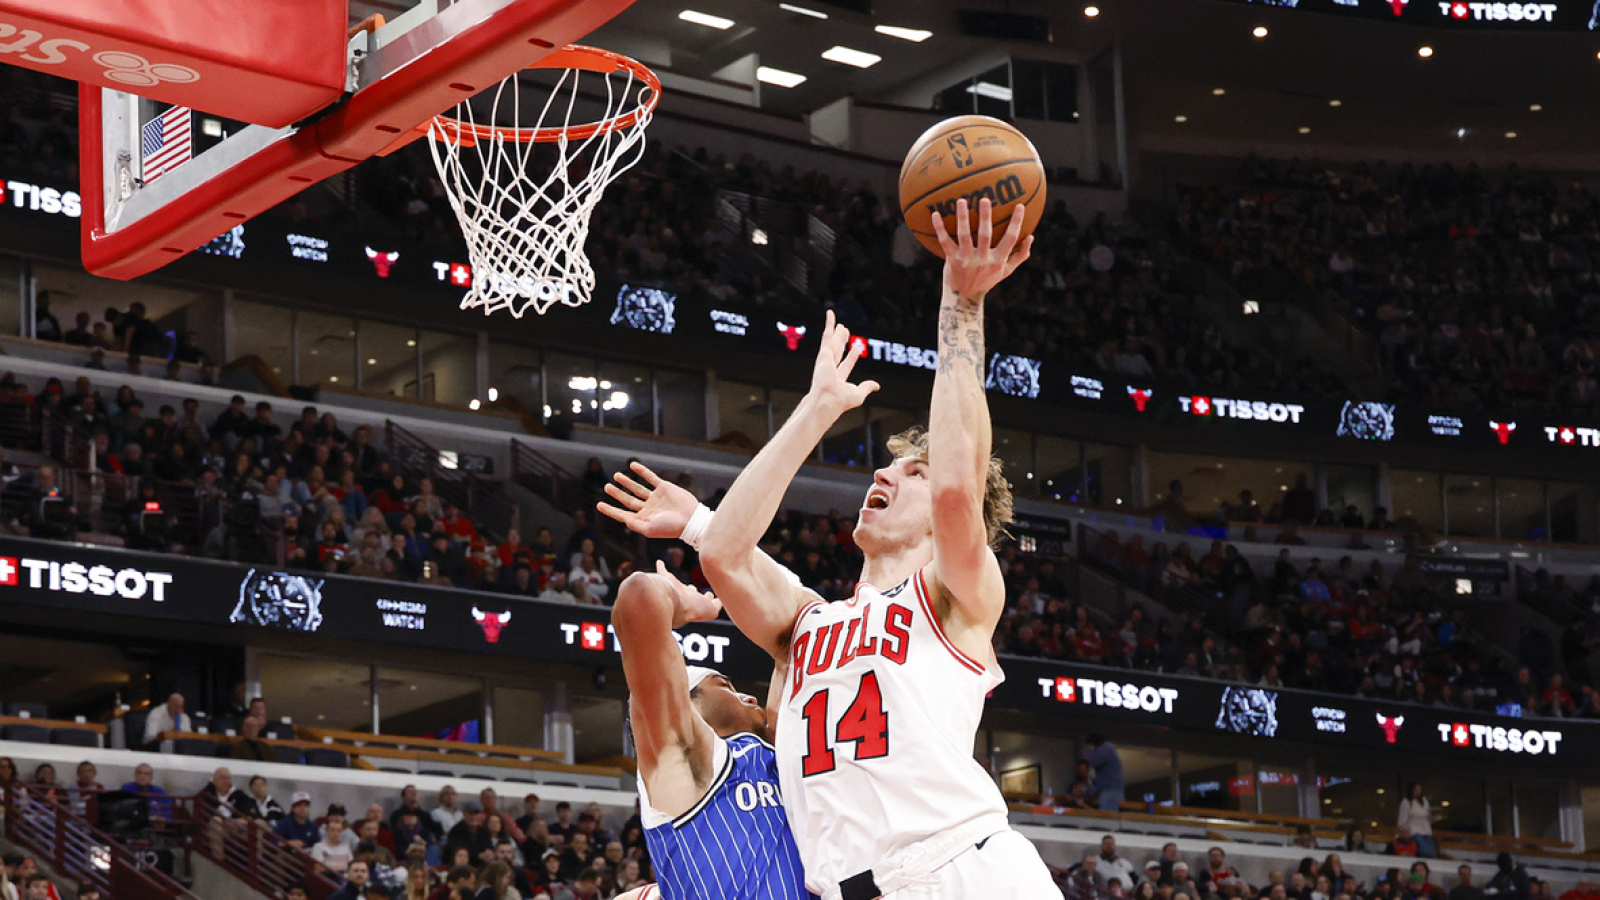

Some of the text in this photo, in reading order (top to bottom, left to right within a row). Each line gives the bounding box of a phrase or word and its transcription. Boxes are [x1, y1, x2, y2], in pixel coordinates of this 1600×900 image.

[1470, 2, 1557, 22] TISSOT
[1211, 398, 1304, 424] TISSOT
[21, 557, 173, 602] TISSOT
[788, 602, 913, 703] BULLS
[1076, 678, 1179, 714] TISSOT
[801, 669, 889, 778] 14
[1469, 723, 1562, 755] TISSOT
